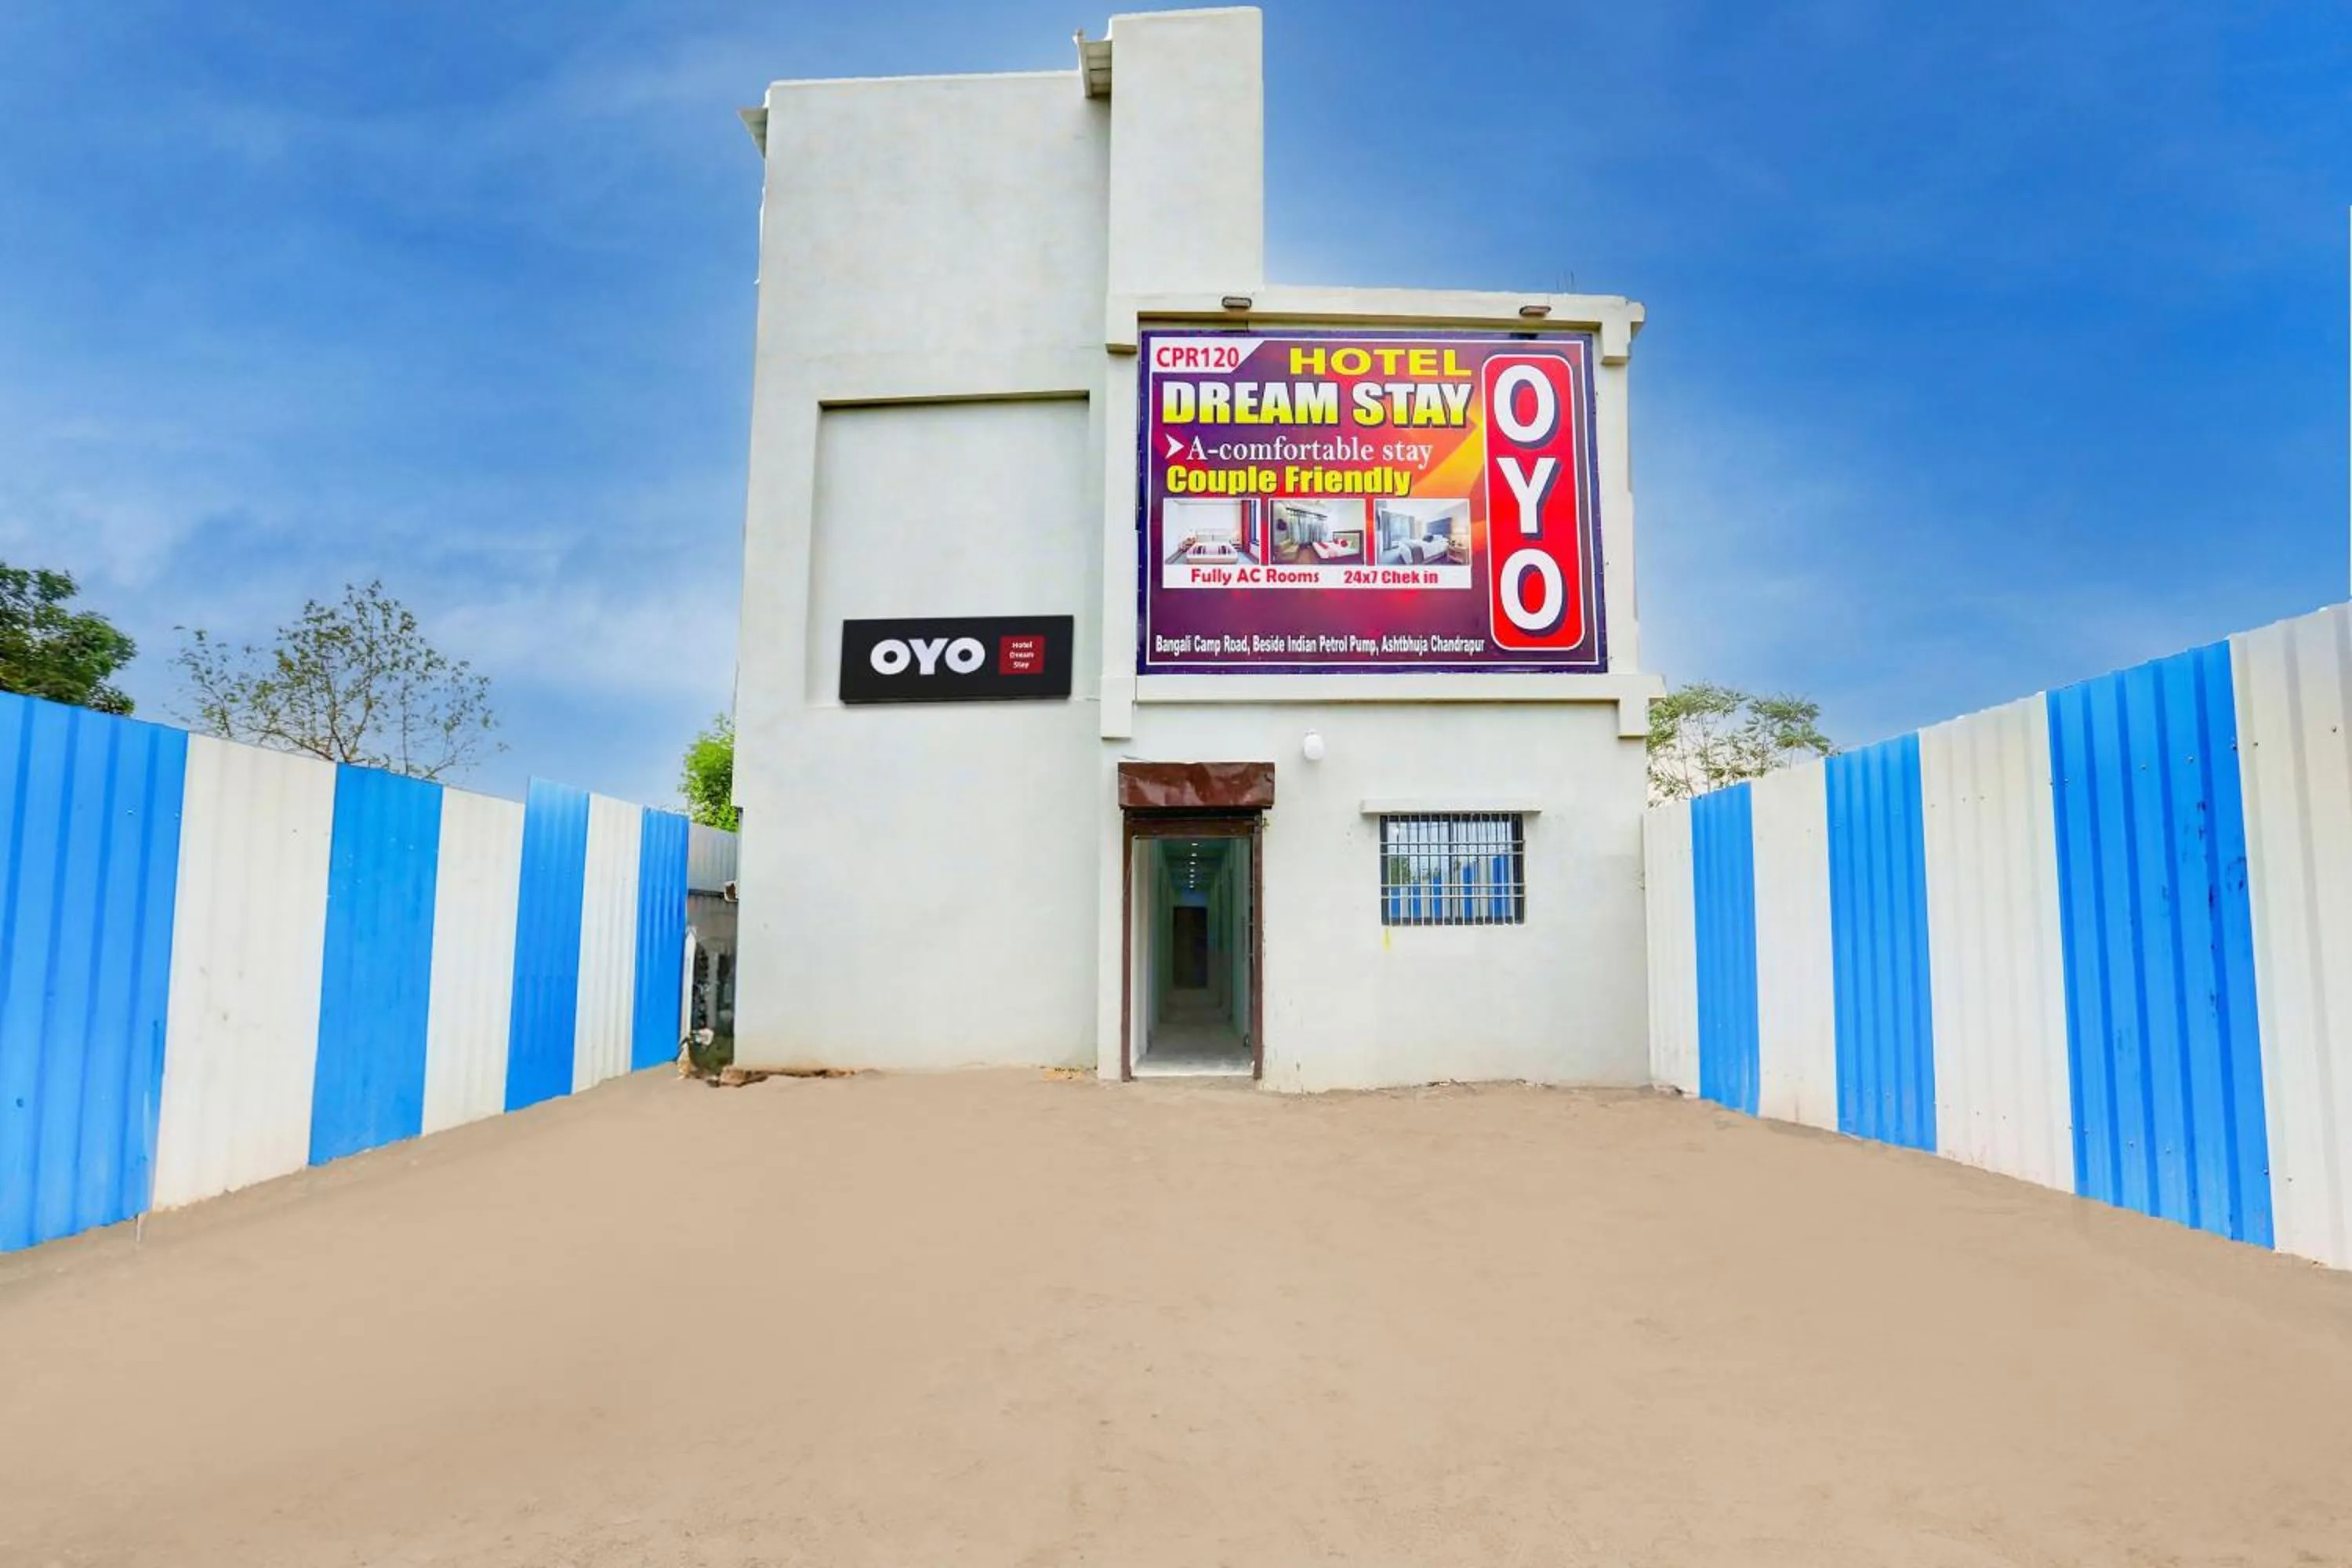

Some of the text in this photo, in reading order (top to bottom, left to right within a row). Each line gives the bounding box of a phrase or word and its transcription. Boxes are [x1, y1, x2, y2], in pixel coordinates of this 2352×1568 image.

[1156, 347, 1240, 368] CPR120
[1290, 347, 1472, 376] HOTEL
[1162, 381, 1474, 427] DREAM STAY
[1187, 436, 1433, 469] A-comfortable stay
[1166, 465, 1412, 497] Couple Friendly
[1494, 365, 1563, 630] OYO
[1191, 568, 1319, 586] Fully AC Rooms
[1344, 570, 1439, 584] 24x7 Chek in
[870, 637, 985, 675] OYO
[1156, 635, 1485, 656] Bangali Camp Road, Beside Indian Petrol Pump, Ashtbhuja Chandrapur
